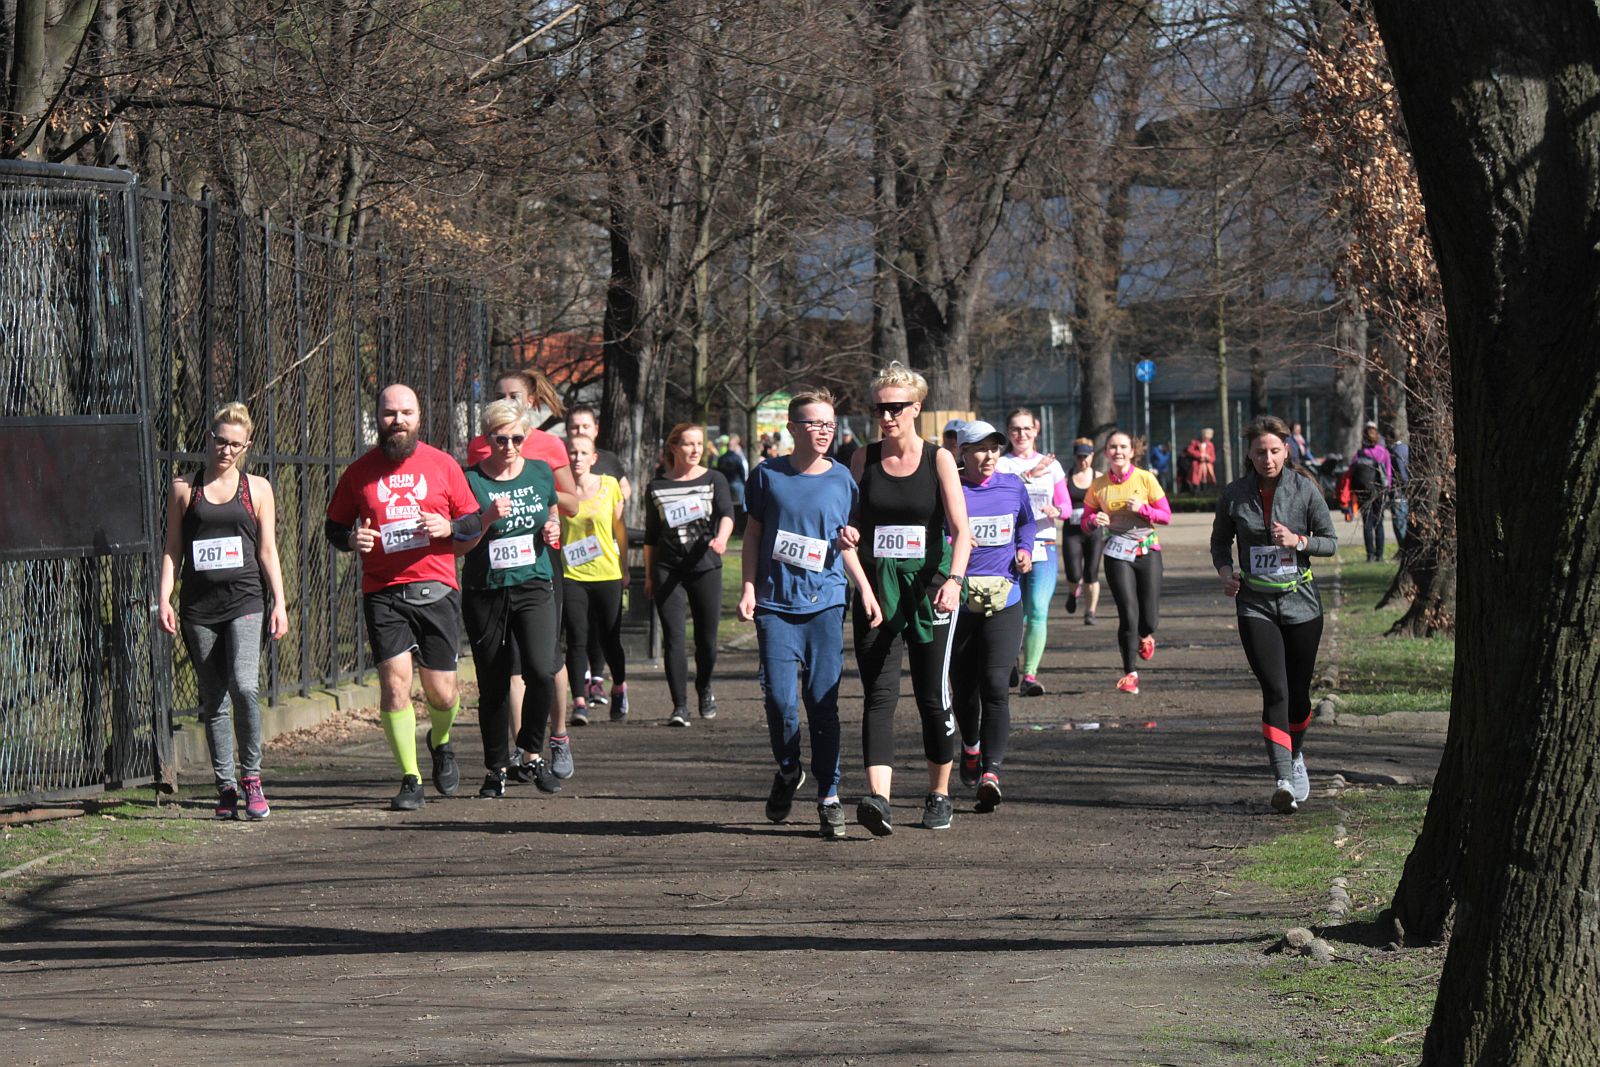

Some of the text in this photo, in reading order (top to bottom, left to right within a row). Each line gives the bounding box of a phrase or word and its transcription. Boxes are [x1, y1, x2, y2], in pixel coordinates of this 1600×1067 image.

[389, 474, 415, 484] RUN
[513, 485, 534, 498] LEFT
[510, 498, 526, 507] ILL
[388, 506, 420, 516] TEAM
[670, 506, 687, 521] 277
[974, 524, 997, 539] 273
[877, 534, 905, 550] 260
[198, 547, 222, 562] 267
[493, 545, 518, 561] 283
[568, 546, 587, 561] 278
[779, 540, 806, 560] 261
[1255, 554, 1277, 568] 272
